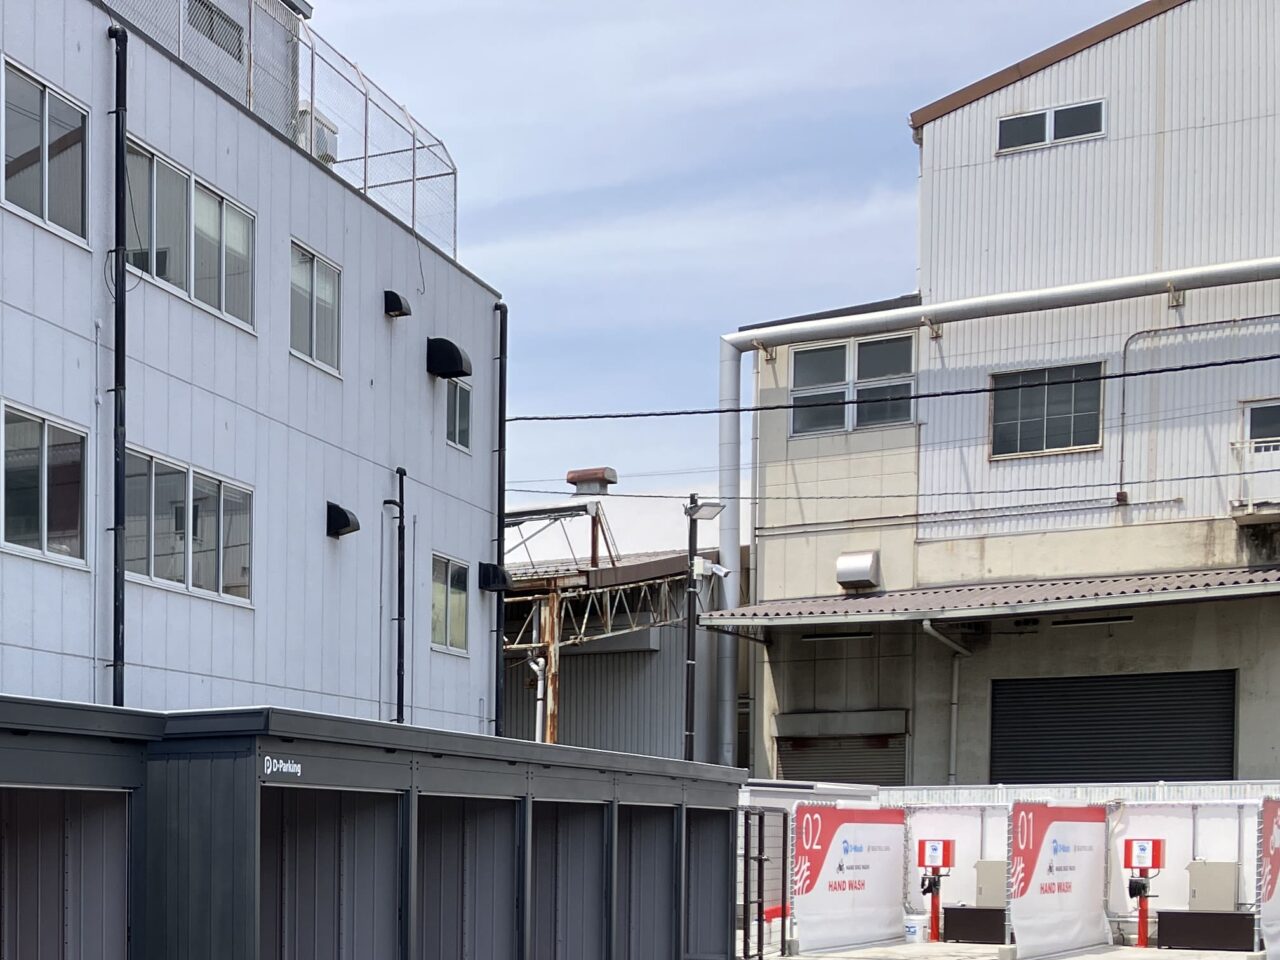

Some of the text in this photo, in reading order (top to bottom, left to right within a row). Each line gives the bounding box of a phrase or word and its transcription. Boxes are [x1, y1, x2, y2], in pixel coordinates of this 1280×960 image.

[272, 759, 302, 777] D-Parking
[802, 813, 822, 850] 02
[1018, 810, 1034, 850] 01
[828, 879, 866, 892] HAND WASH
[1040, 881, 1073, 894] HAND WASH
